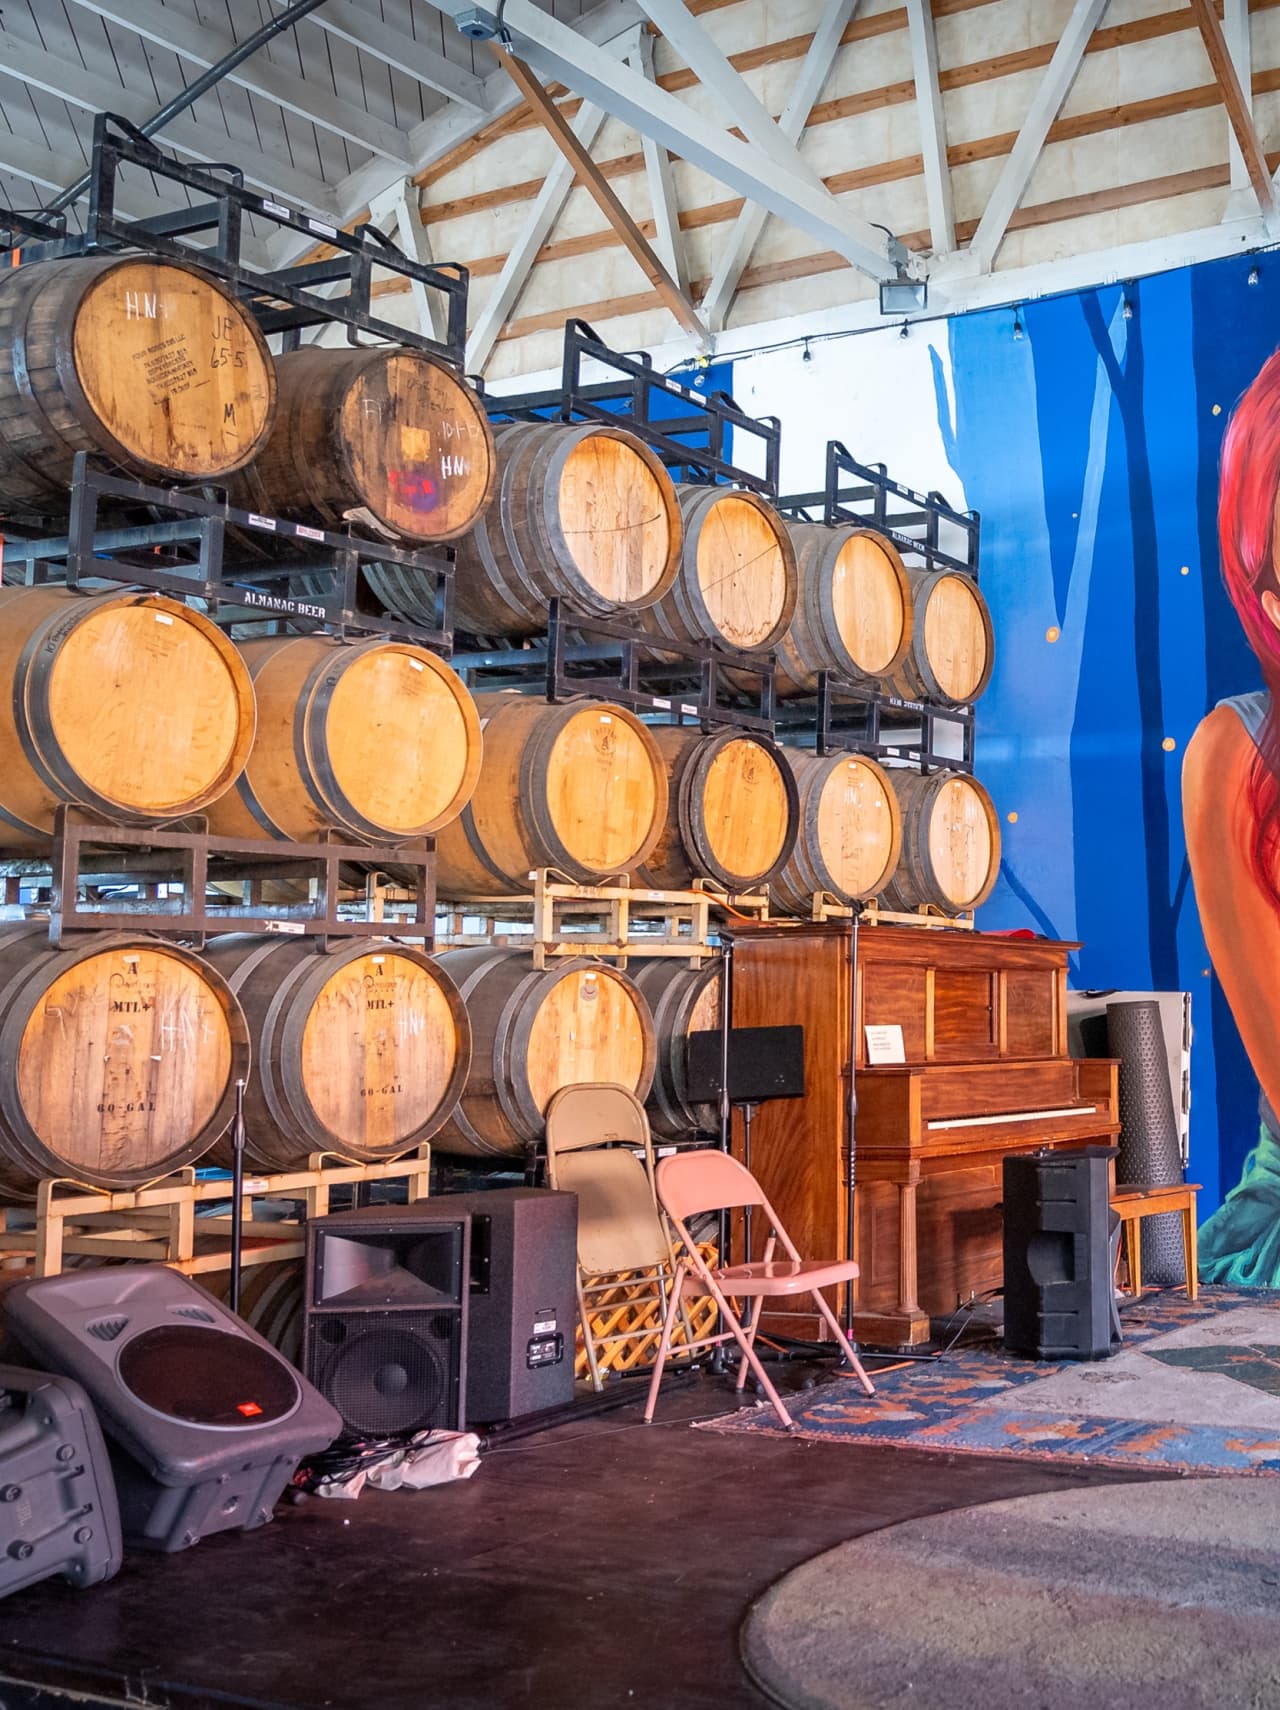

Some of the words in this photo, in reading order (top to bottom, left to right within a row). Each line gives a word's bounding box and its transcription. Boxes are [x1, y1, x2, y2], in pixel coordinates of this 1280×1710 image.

[244, 591, 295, 612] ALMANAC
[297, 602, 326, 619] BEER
[127, 962, 138, 975] A
